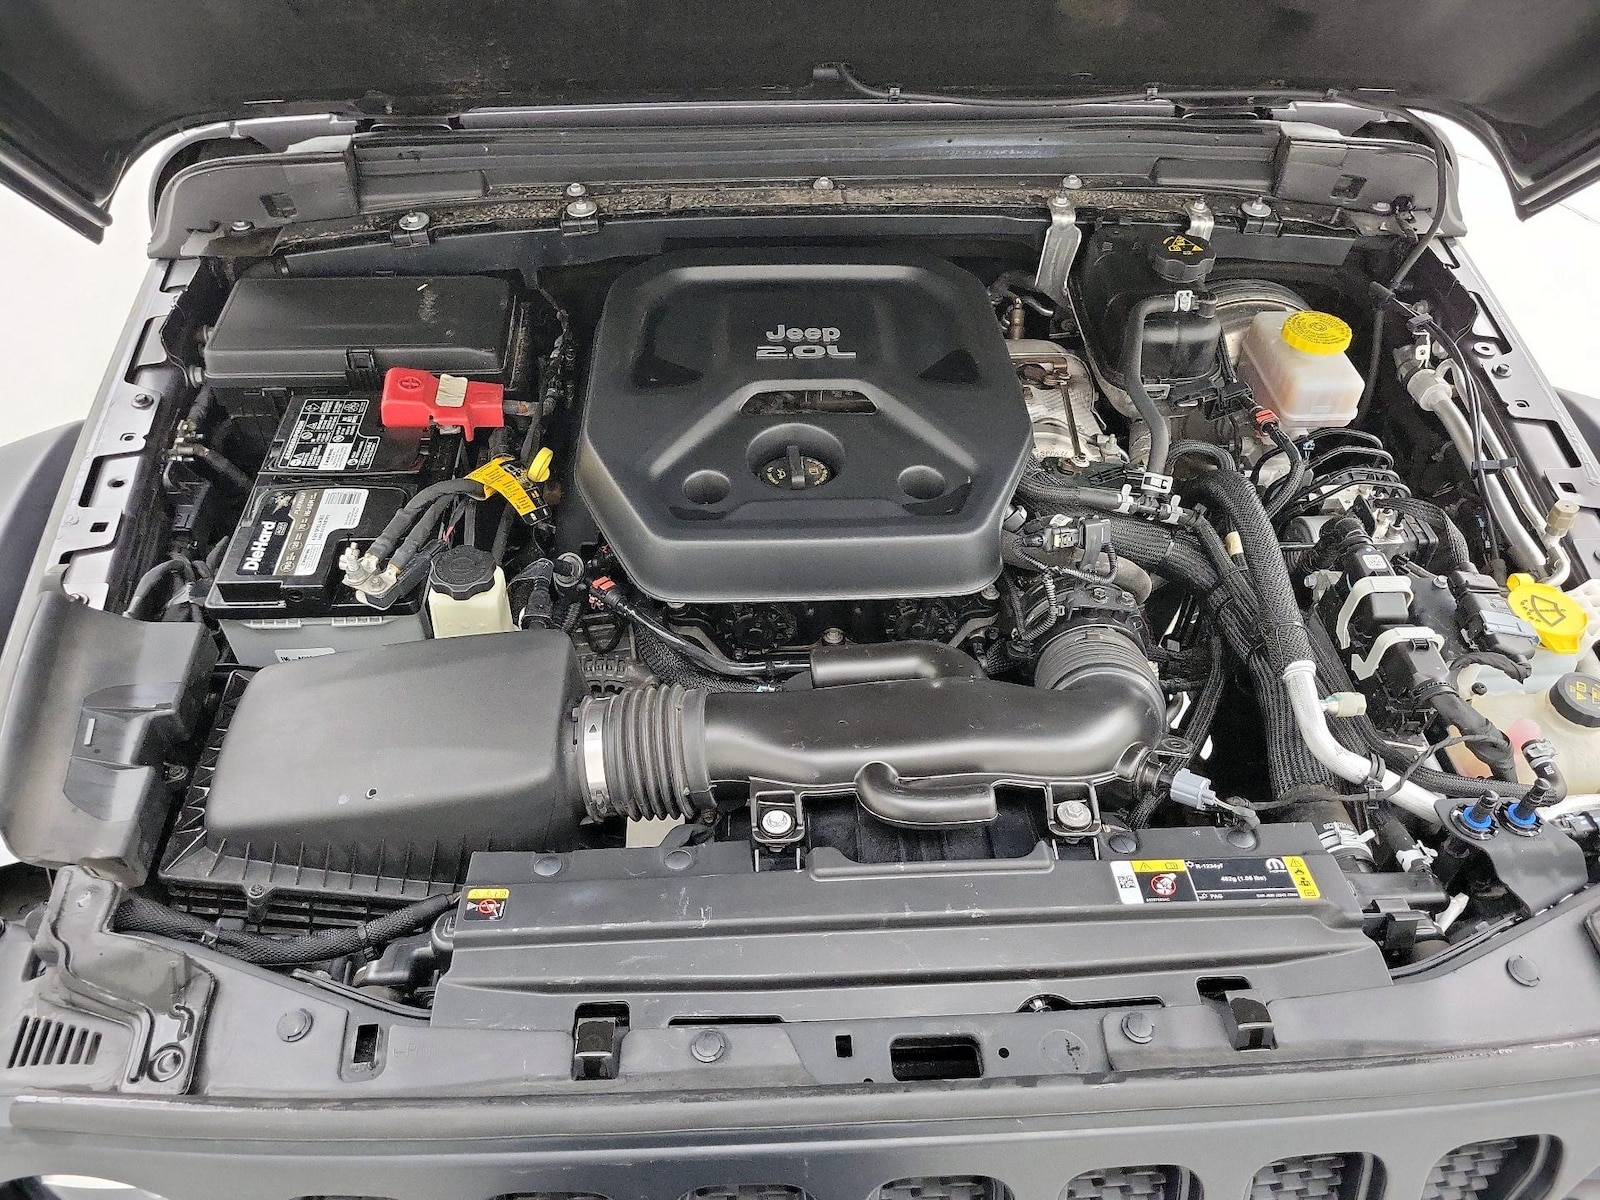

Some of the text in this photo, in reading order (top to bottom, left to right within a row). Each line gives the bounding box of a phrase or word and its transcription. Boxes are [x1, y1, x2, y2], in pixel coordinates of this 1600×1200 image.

[766, 324, 841, 343] Jeep
[756, 345, 857, 359] 2.0L
[242, 520, 277, 571] DieHard
[1194, 862, 1224, 870] R-1234yf
